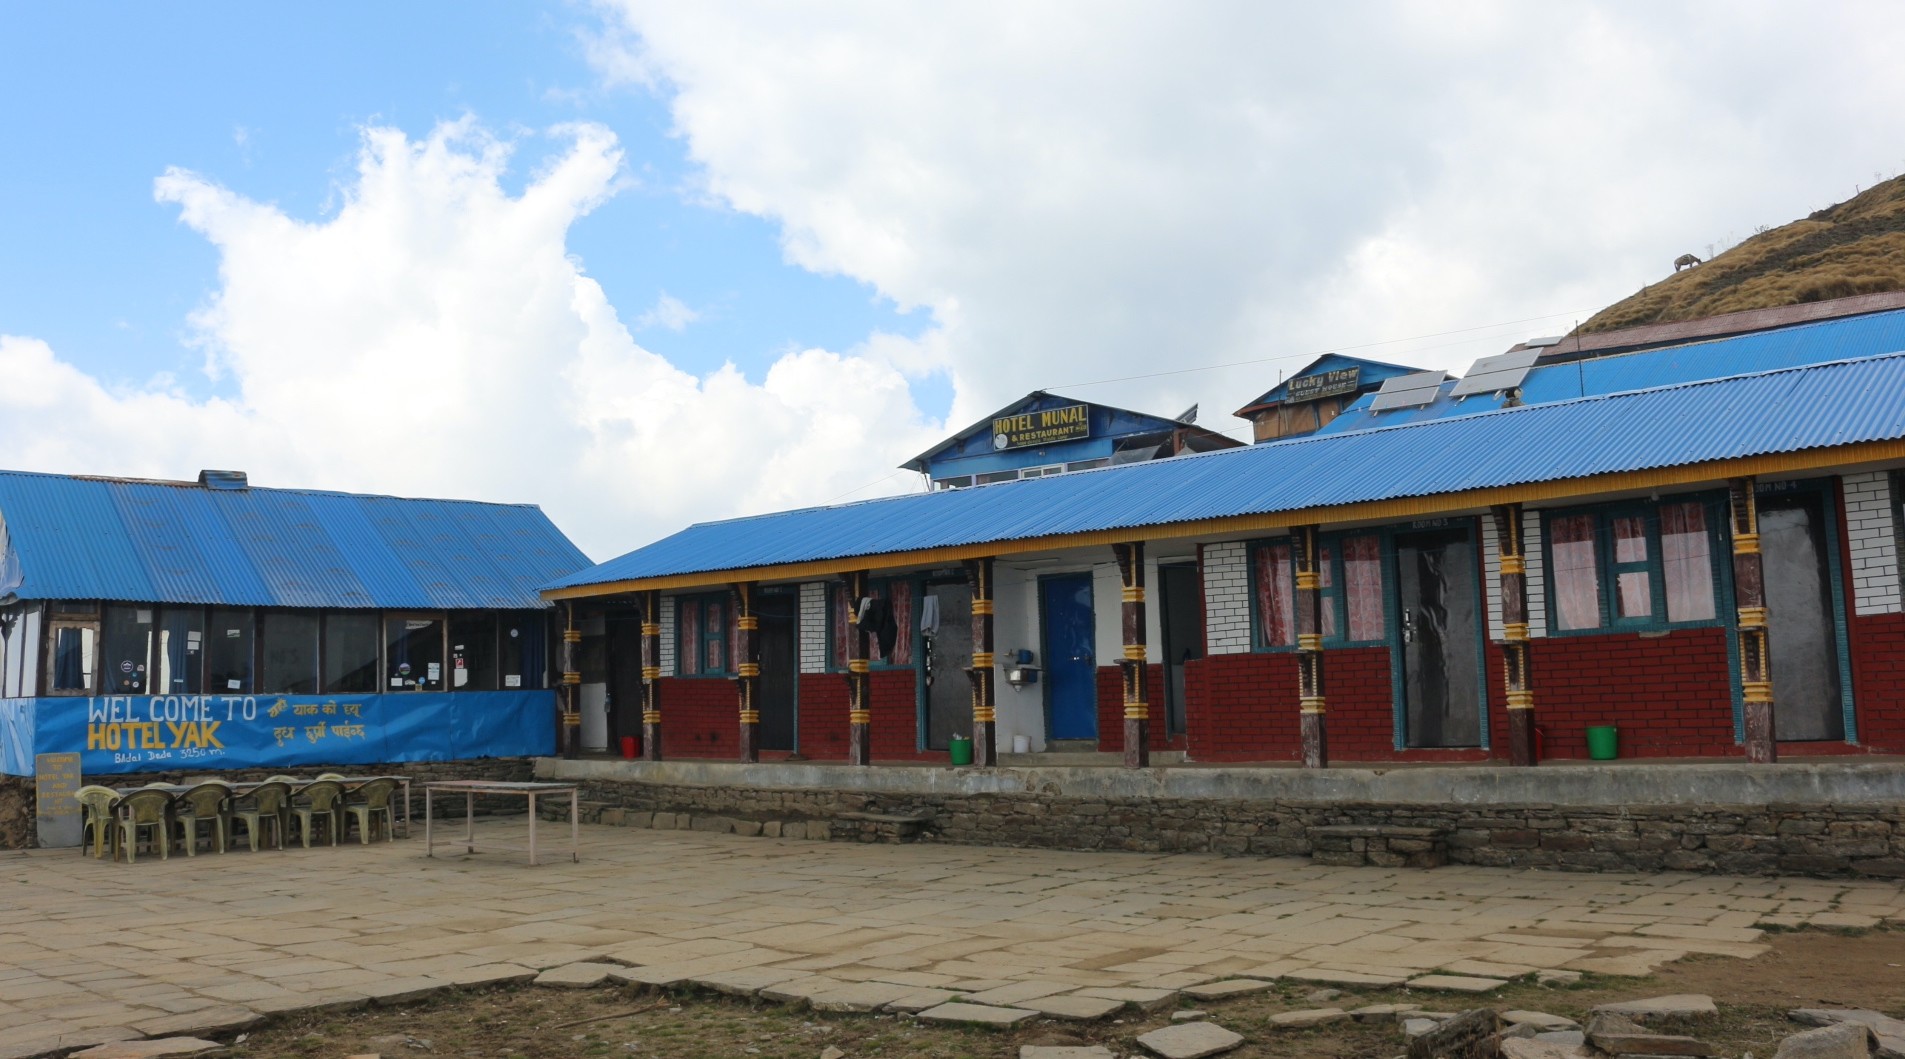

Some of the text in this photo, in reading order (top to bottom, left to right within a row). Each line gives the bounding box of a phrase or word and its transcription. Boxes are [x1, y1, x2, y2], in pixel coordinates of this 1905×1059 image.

[1289, 369, 1357, 391] Lucky View
[994, 406, 1087, 435] HOTEL MUNAL
[1011, 434, 1018, 442] &
[1019, 425, 1075, 441] RESTAURANT
[88, 696, 257, 722] WEL COME TO
[87, 721, 225, 750] HOTEL YAK
[180, 747, 206, 759] 3250
